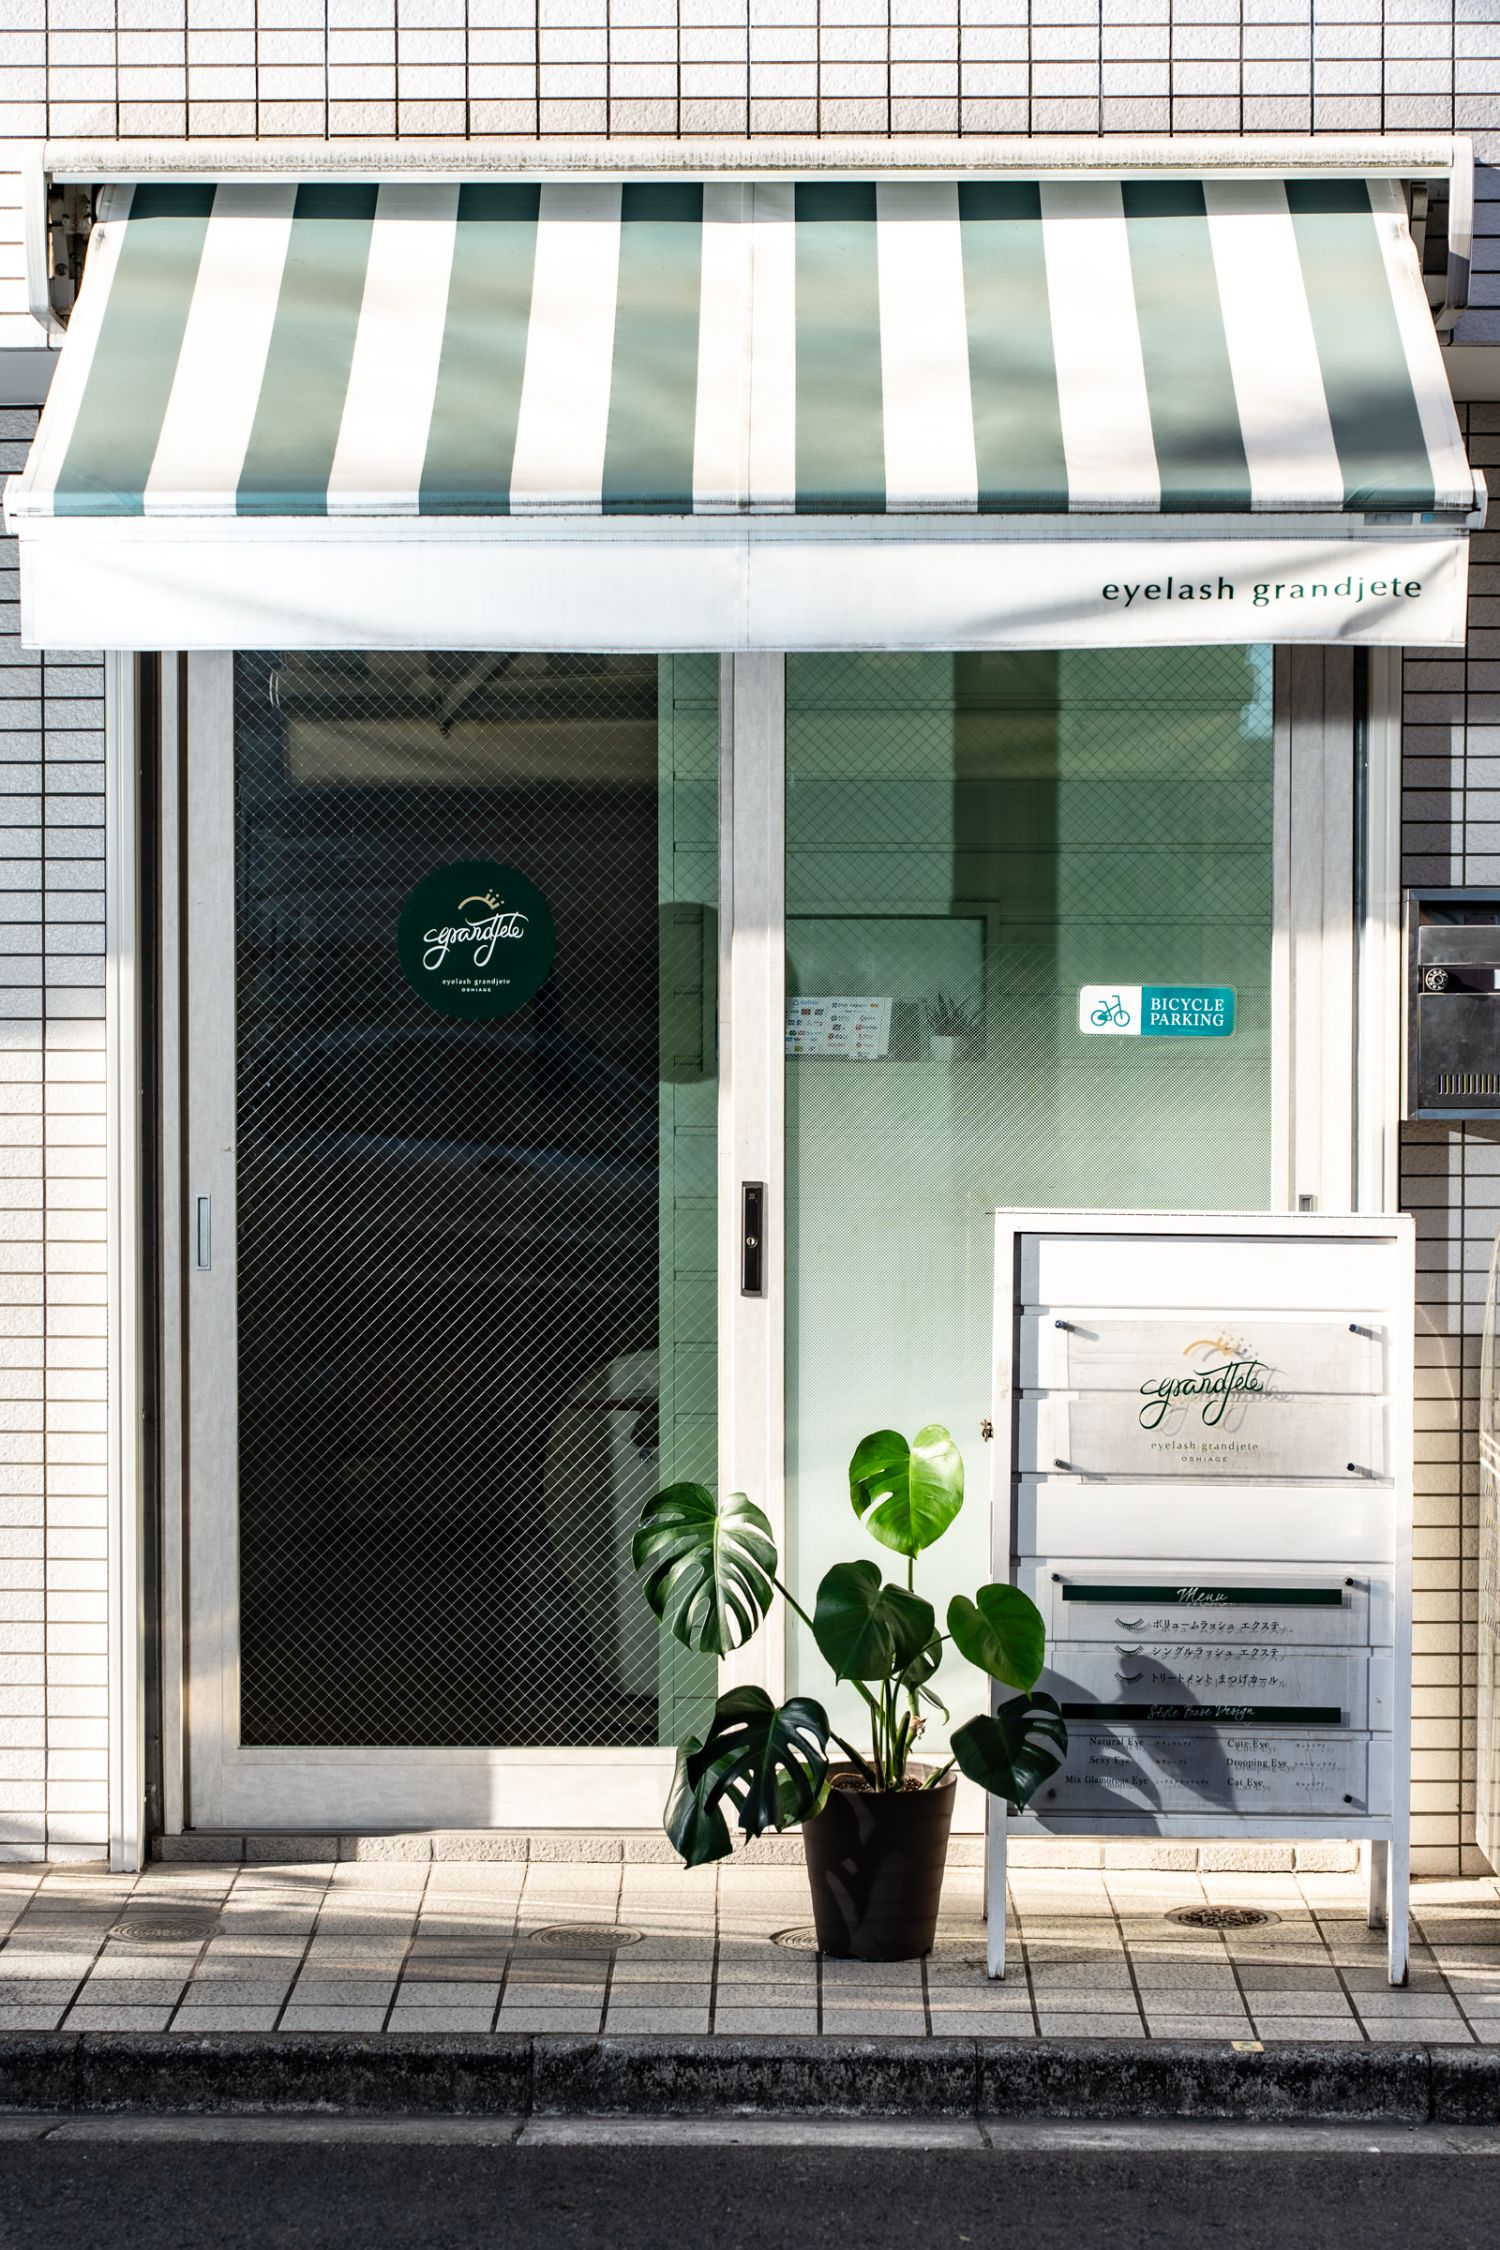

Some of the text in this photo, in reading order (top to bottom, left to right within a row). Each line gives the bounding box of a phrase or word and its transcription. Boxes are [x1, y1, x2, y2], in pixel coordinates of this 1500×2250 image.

[1102, 576, 1422, 607] eyelash grandjete
[442, 977, 511, 987] eyelash grandjete
[1150, 997, 1225, 1012] BICYCLE
[1150, 1012, 1225, 1027] PARKING
[1150, 1440, 1259, 1453] eyelash grandjete
[1177, 1586, 1229, 1603] Menu
[1241, 1620, 1280, 1632] エクステ
[1152, 1645, 1280, 1658] シングルラッシュ エクステ
[1152, 1673, 1279, 1685] トリートメント まつげカール
[1147, 1704, 1256, 1721] Style Base Design
[1089, 1736, 1124, 1746] Natural
[1127, 1737, 1145, 1748] Eye
[1227, 1740, 1270, 1751] Cute Eye
[1089, 1755, 1131, 1767] Sexy Eye
[1226, 1758, 1268, 1770] Drooping
[1271, 1759, 1288, 1770] Eye
[1065, 1775, 1081, 1785] Mix
[1084, 1775, 1129, 1785] Glamorous
[1131, 1775, 1149, 1786] Eye
[1227, 1777, 1264, 1789] Cat Eye
